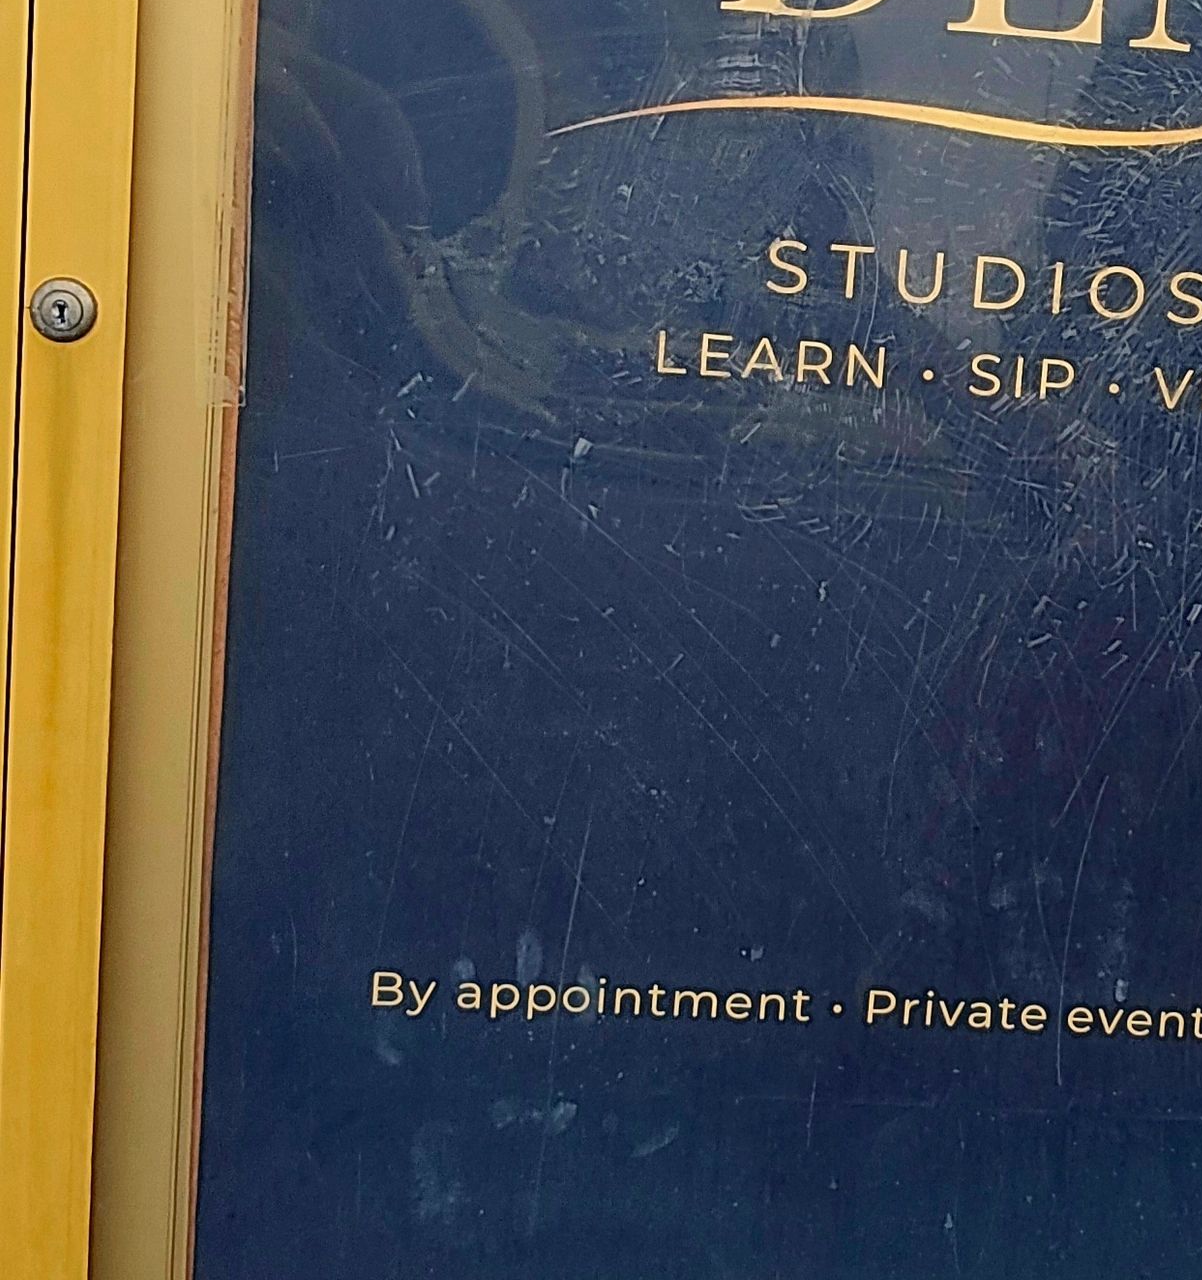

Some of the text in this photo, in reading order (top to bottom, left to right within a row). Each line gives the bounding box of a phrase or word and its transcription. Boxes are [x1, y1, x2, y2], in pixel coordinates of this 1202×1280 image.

[656, 330, 887, 390] LEARN
[968, 353, 1076, 400] SIP
[371, 971, 437, 1018] By
[456, 976, 811, 1023] appointment
[866, 989, 1048, 1032] Private
